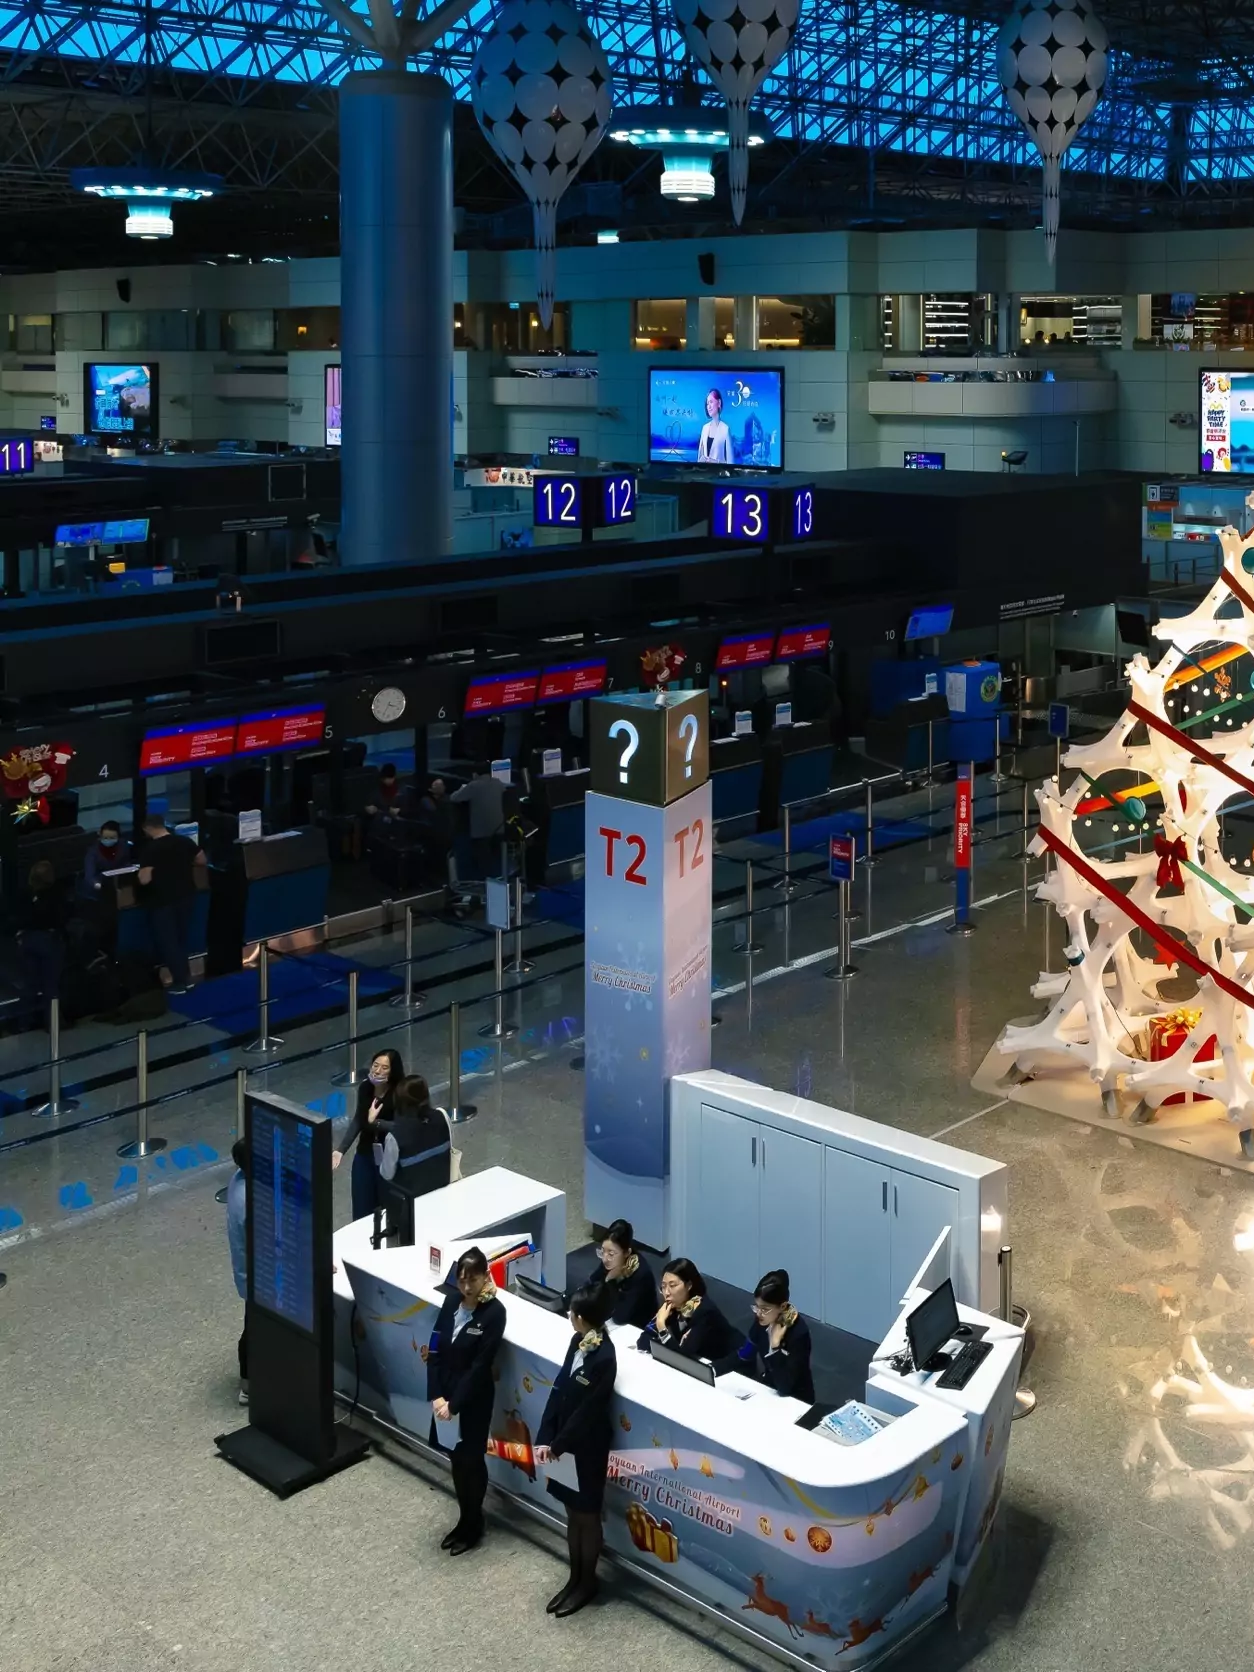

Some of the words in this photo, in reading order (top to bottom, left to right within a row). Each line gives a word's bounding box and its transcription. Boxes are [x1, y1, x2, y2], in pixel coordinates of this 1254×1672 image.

[2, 442, 25, 471] 11
[543, 483, 576, 521] 12
[608, 479, 632, 519] 12
[795, 491, 812, 535] 13
[721, 493, 762, 536] 13
[828, 640, 834, 651] 9
[885, 630, 896, 641] 10
[695, 662, 702, 674] 8
[608, 678, 614, 689] 7
[438, 706, 446, 719] 6
[325, 725, 334, 739] 5
[99, 764, 109, 778] 4
[599, 825, 648, 886] T2
[674, 817, 705, 880] T2
[593, 971, 613, 988] Merry
[614, 976, 652, 994] Christmas
[607, 1465, 651, 1502] Merry
[656, 1486, 733, 1536] Christmas
[608, 1454, 637, 1473] oyuan
[640, 1464, 702, 1502] International
[704, 1494, 741, 1518] Airport
